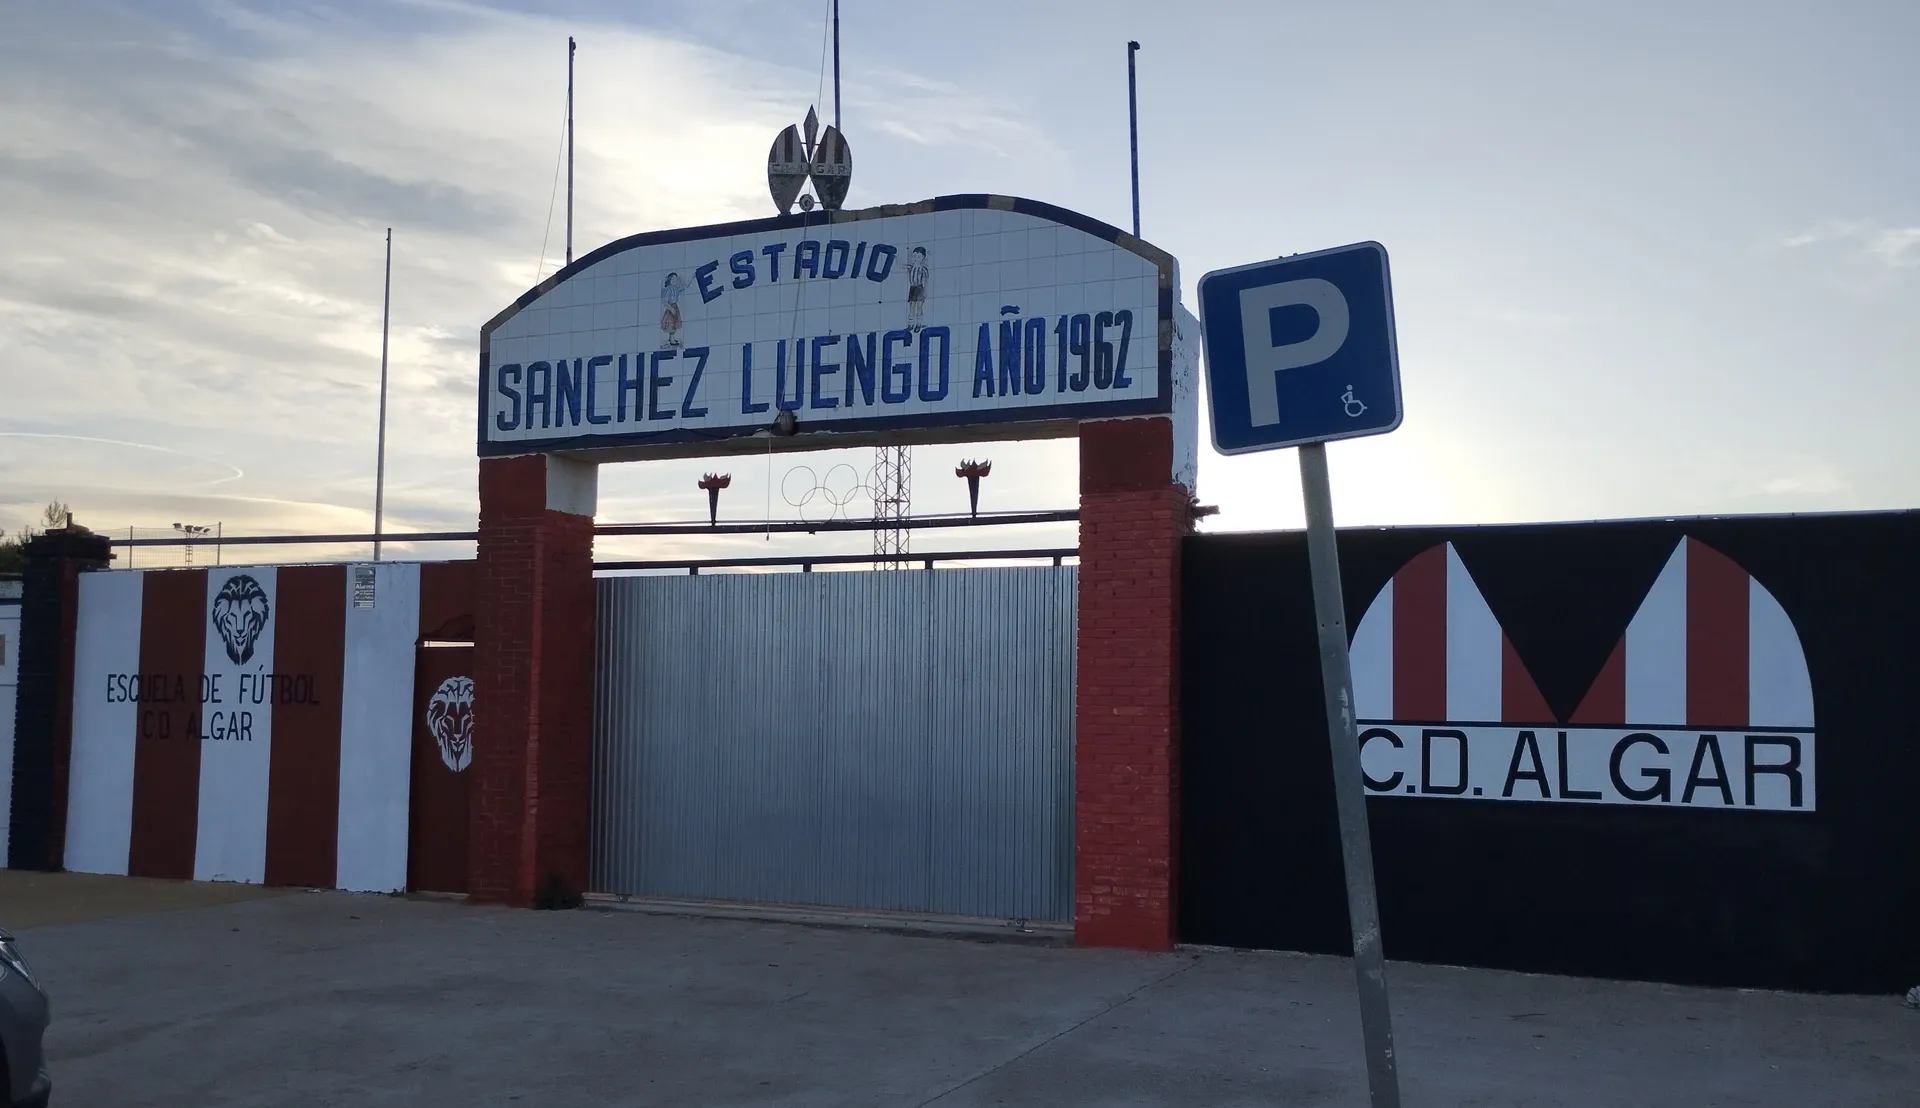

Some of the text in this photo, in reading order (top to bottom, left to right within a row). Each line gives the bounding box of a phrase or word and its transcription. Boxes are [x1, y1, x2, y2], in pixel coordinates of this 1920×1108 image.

[695, 239, 897, 304] ESTADIO
[496, 305, 1133, 431] SANCHEZ LUENGO AÑO 1962
[1239, 278, 1350, 427] P
[107, 665, 320, 705] ESCUELA DE FÚTBOL
[186, 711, 253, 741] ALGAR
[1358, 728, 1803, 807] C.D. ALGAR
